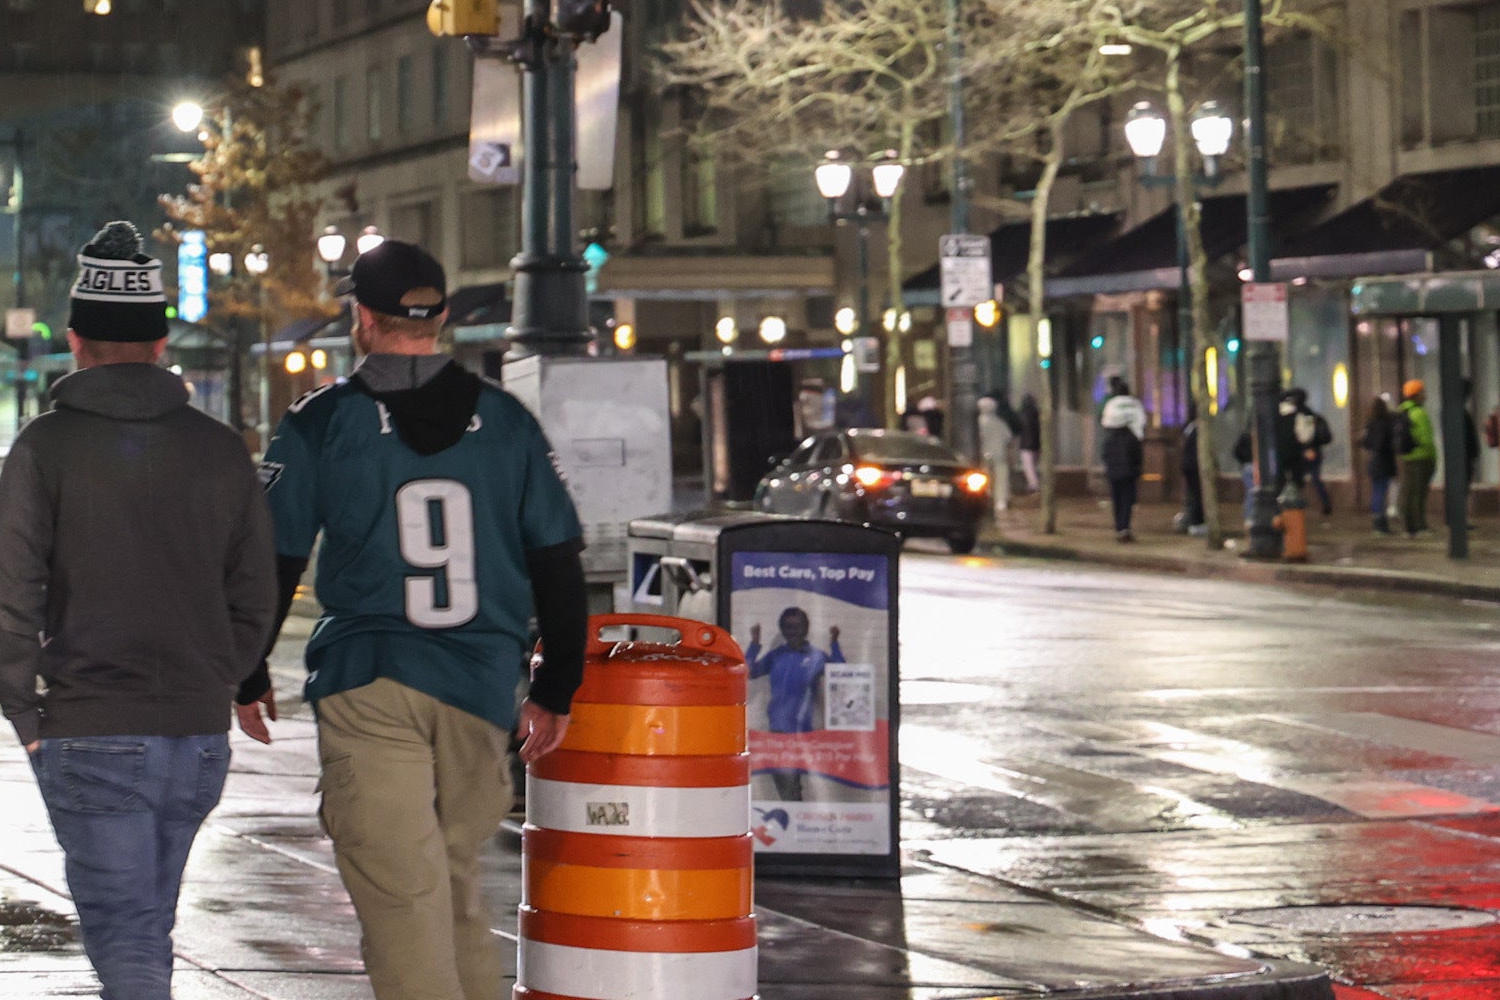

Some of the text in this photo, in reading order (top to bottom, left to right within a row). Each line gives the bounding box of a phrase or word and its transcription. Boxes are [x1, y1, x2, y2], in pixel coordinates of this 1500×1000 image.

[395, 478, 479, 629] 9
[743, 565, 875, 582] Best Care, Top Pay
